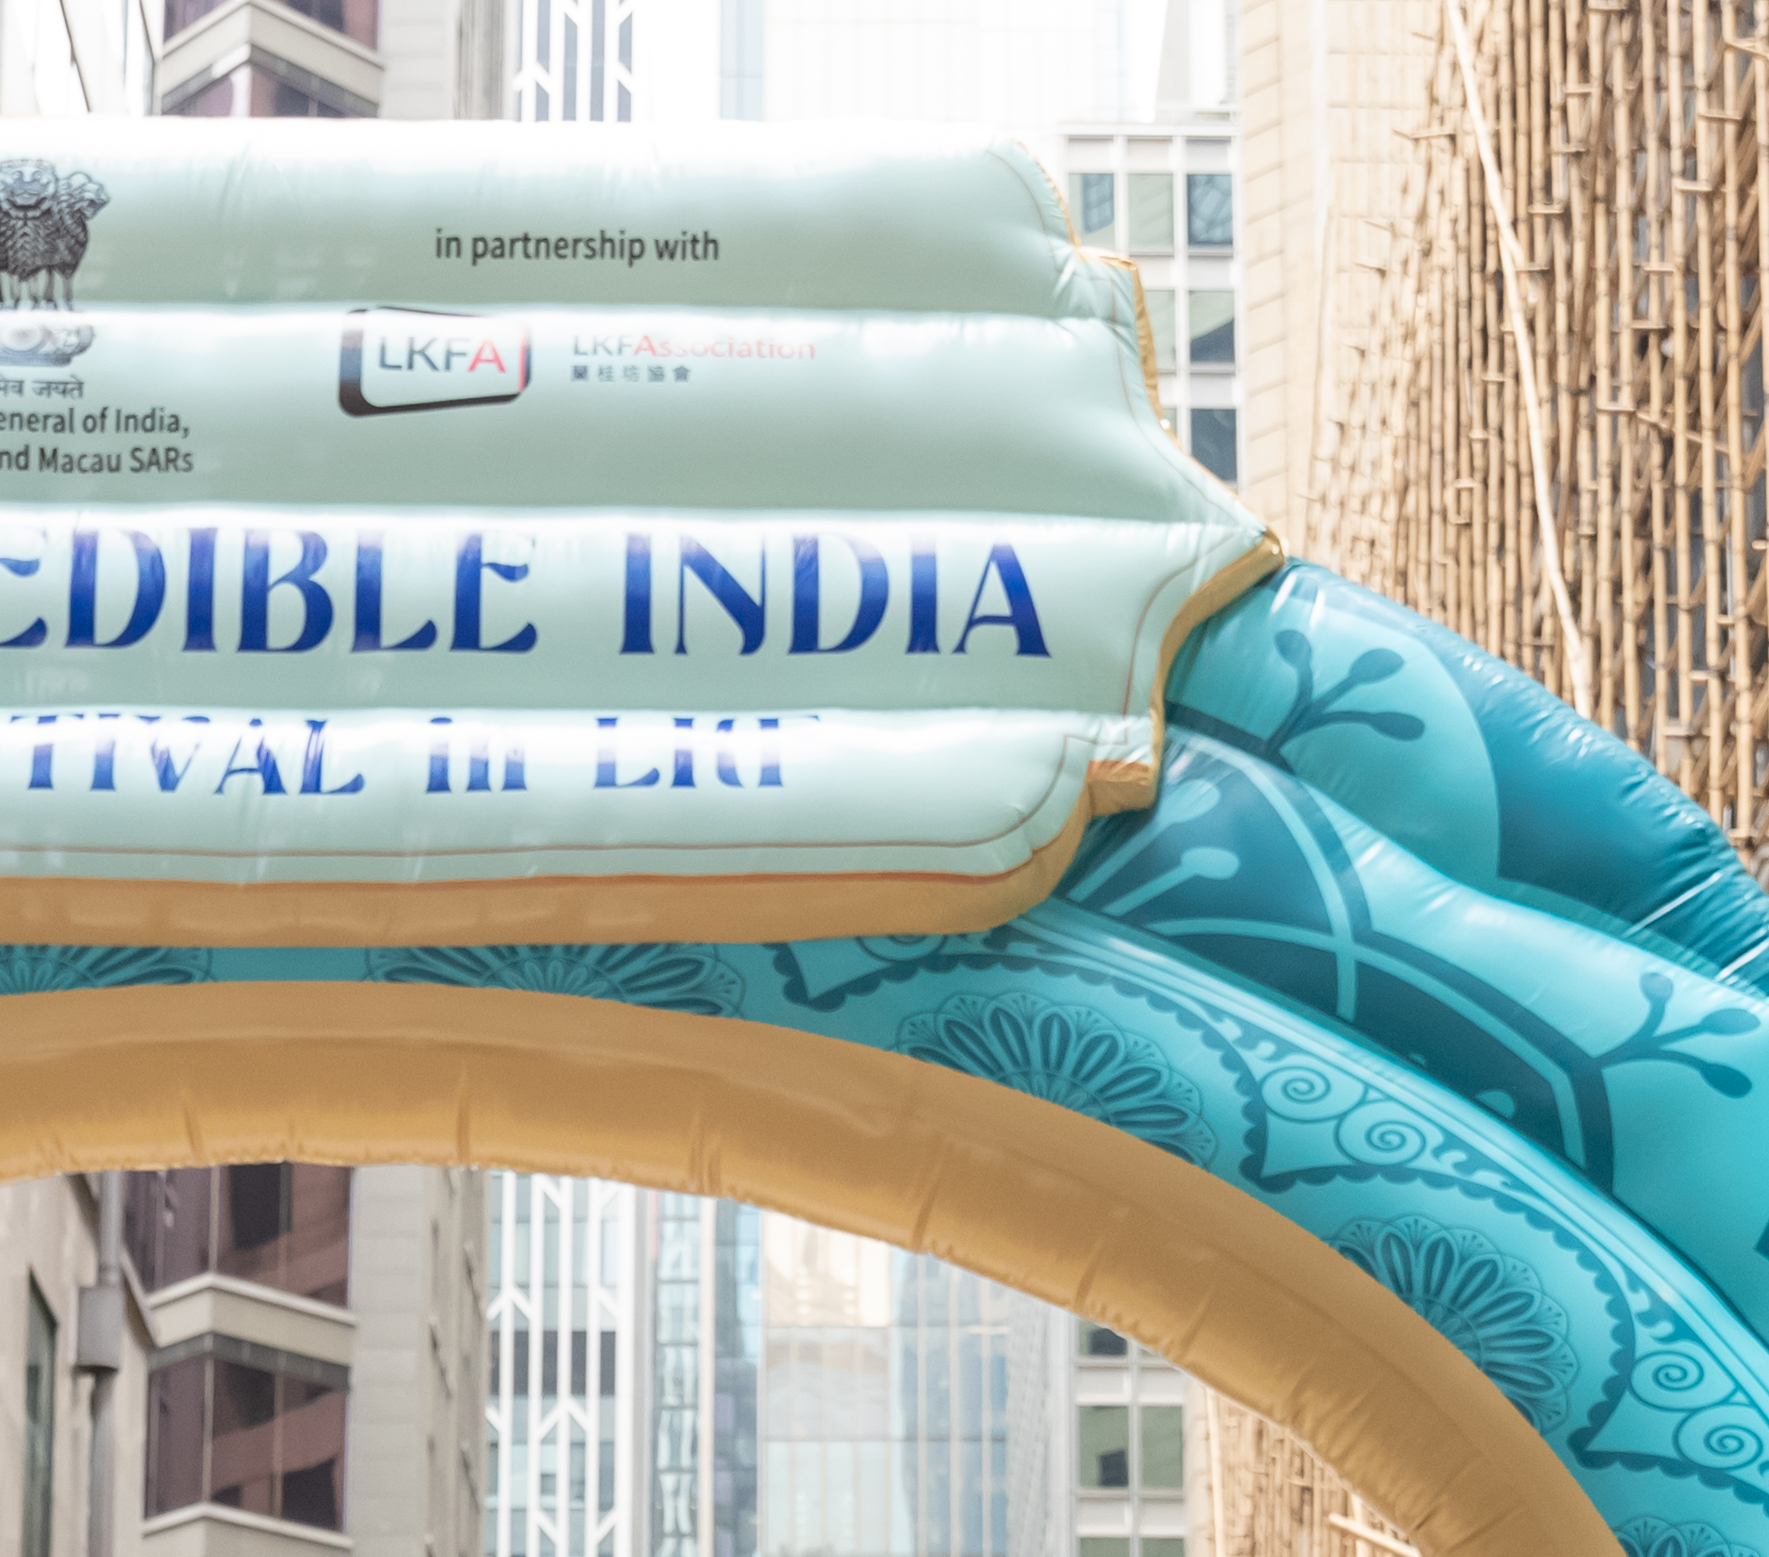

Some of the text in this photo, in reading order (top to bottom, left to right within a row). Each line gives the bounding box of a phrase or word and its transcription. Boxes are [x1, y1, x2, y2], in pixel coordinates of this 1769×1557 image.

[435, 228, 719, 267] in partnership with
[378, 336, 507, 374] LKFA
[32, 374, 85, 400] जयते
[82, 406, 109, 433] of
[115, 407, 190, 438] India,
[38, 447, 121, 474] Macau
[129, 447, 194, 474] SARs
[618, 526, 1053, 659] INDIA
